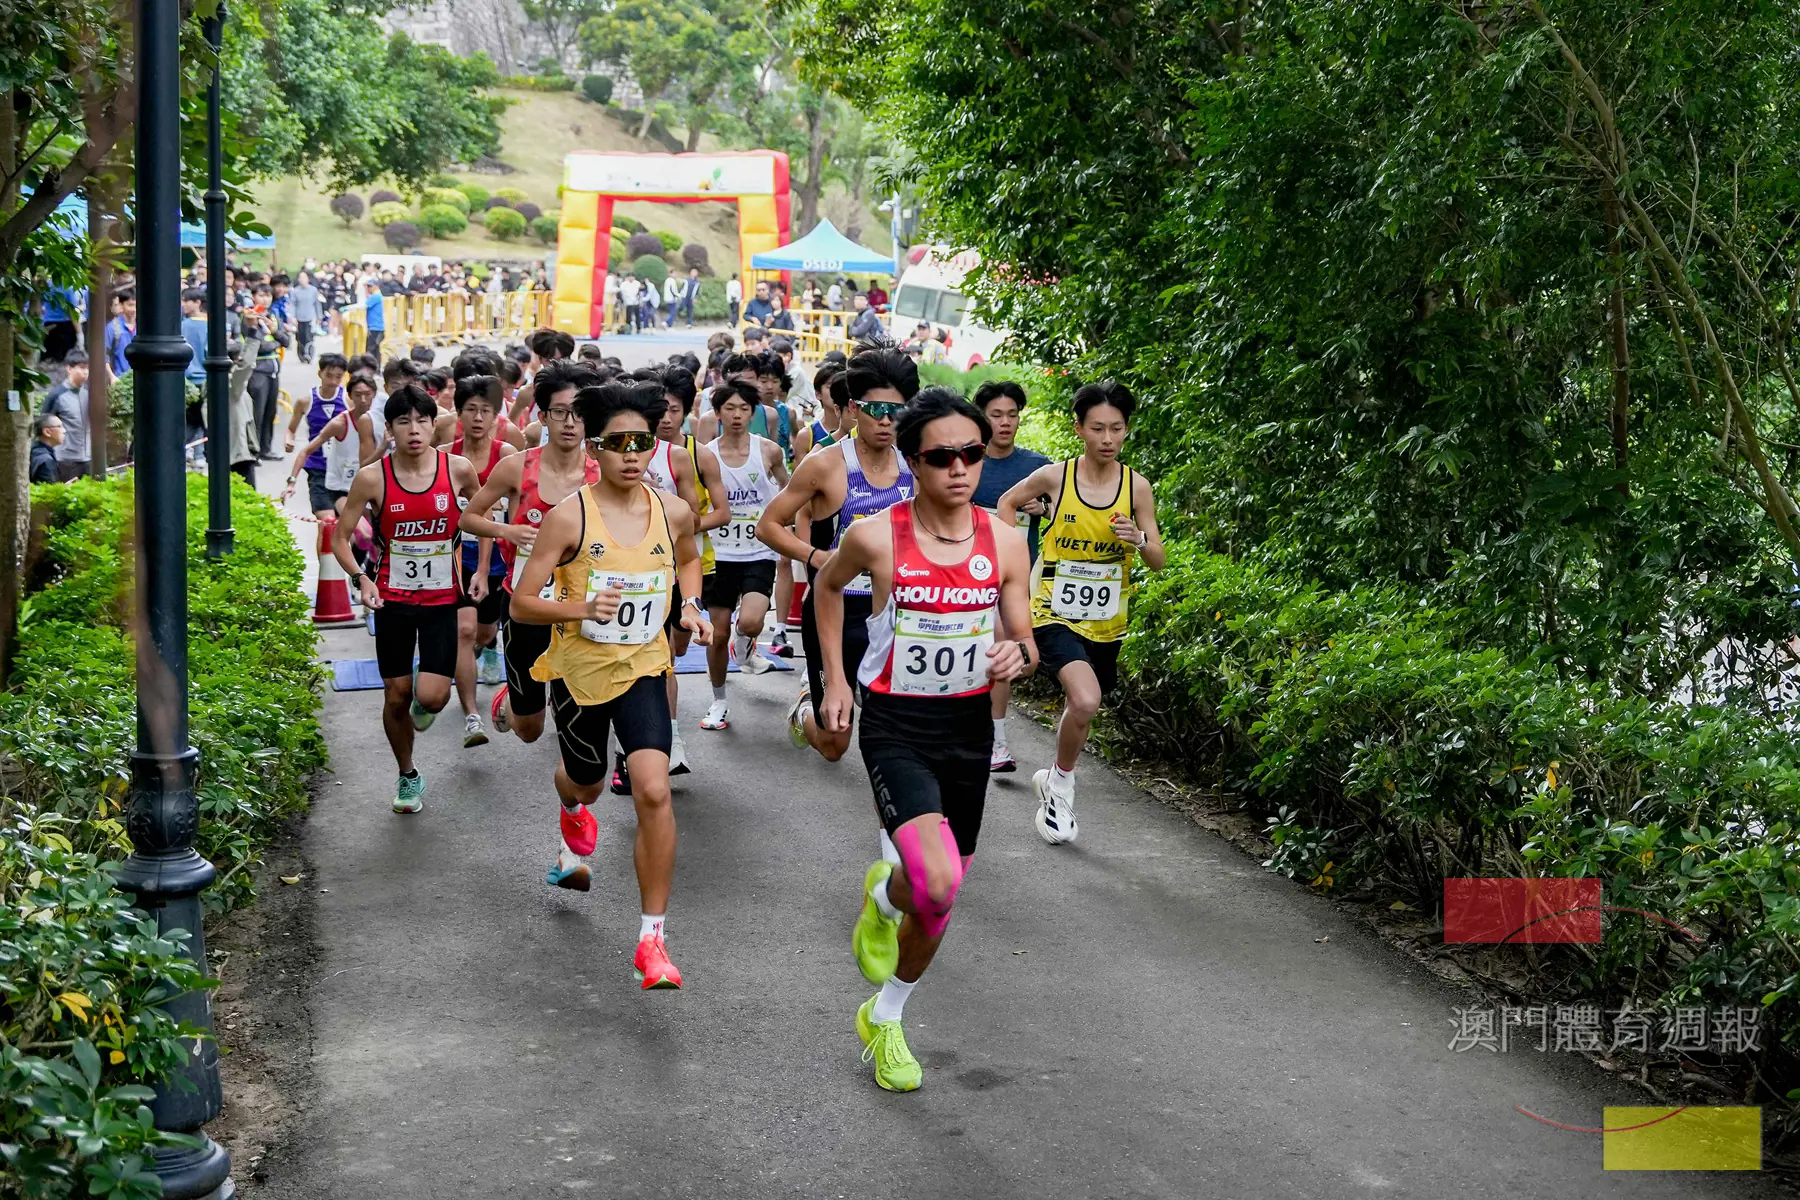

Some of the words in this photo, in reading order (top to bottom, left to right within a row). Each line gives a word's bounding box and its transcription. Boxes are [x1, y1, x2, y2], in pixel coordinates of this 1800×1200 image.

[802, 259, 843, 270] DSEDJ
[718, 523, 756, 539] 519
[1056, 536, 1091, 552] YUET
[405, 560, 432, 578] 31
[895, 586, 939, 603] HOU
[942, 587, 998, 605] KONG
[1061, 583, 1111, 607] 599
[905, 643, 977, 677] 301
